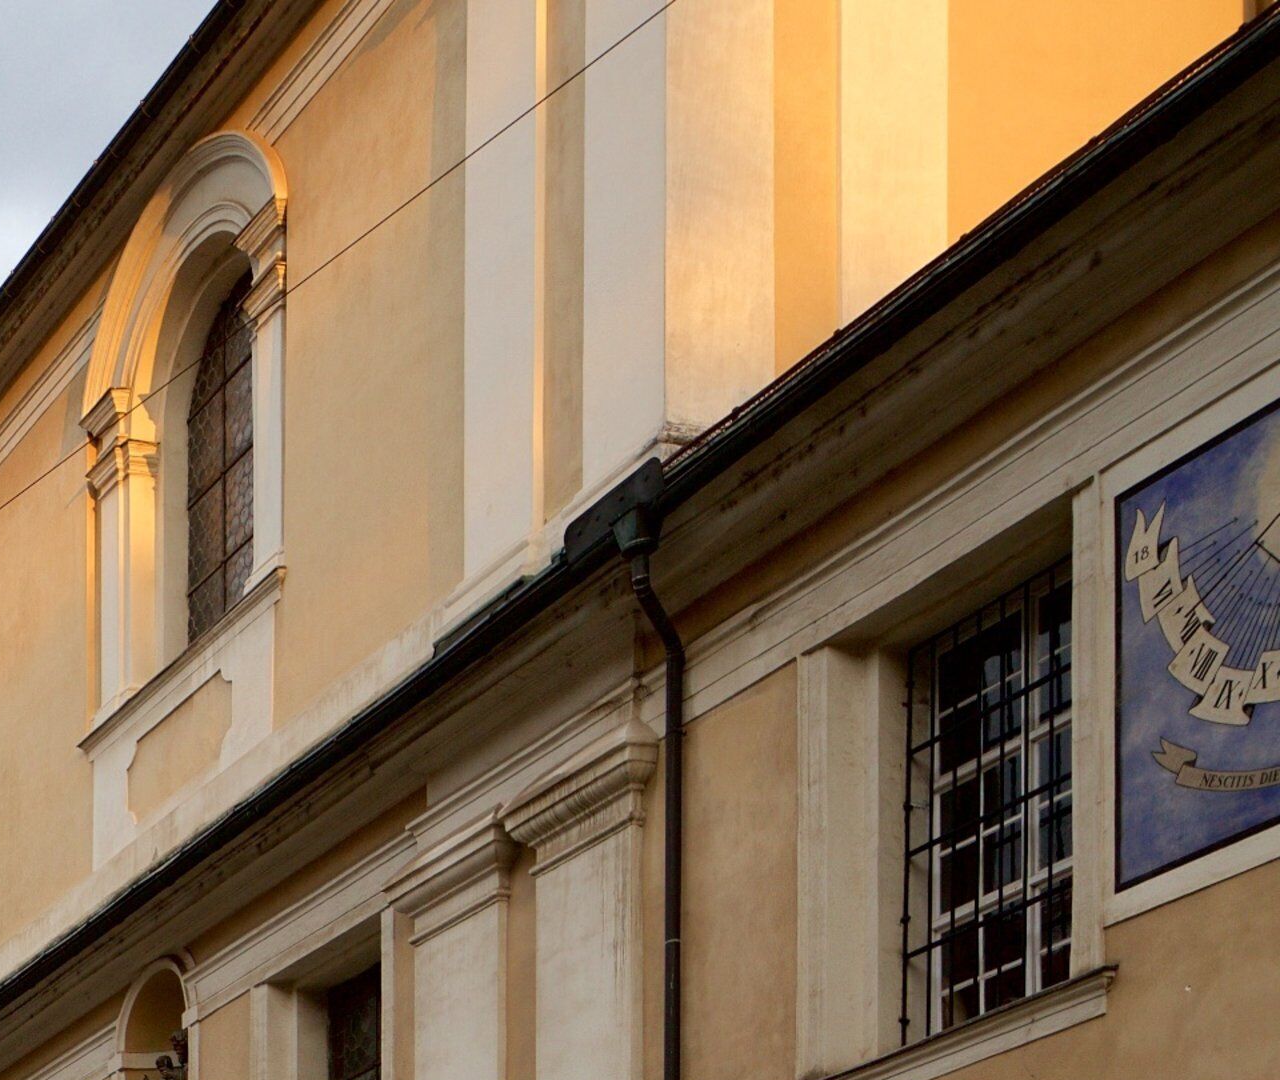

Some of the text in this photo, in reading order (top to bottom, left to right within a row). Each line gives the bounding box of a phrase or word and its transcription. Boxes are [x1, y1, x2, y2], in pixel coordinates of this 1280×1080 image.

[1134, 546, 1149, 564] 18
[1152, 579, 1173, 608] VI
[1191, 643, 1218, 682] VIII
[1254, 661, 1273, 690] X
[1213, 679, 1241, 710] IX
[1200, 772, 1256, 788] NESCITIS
